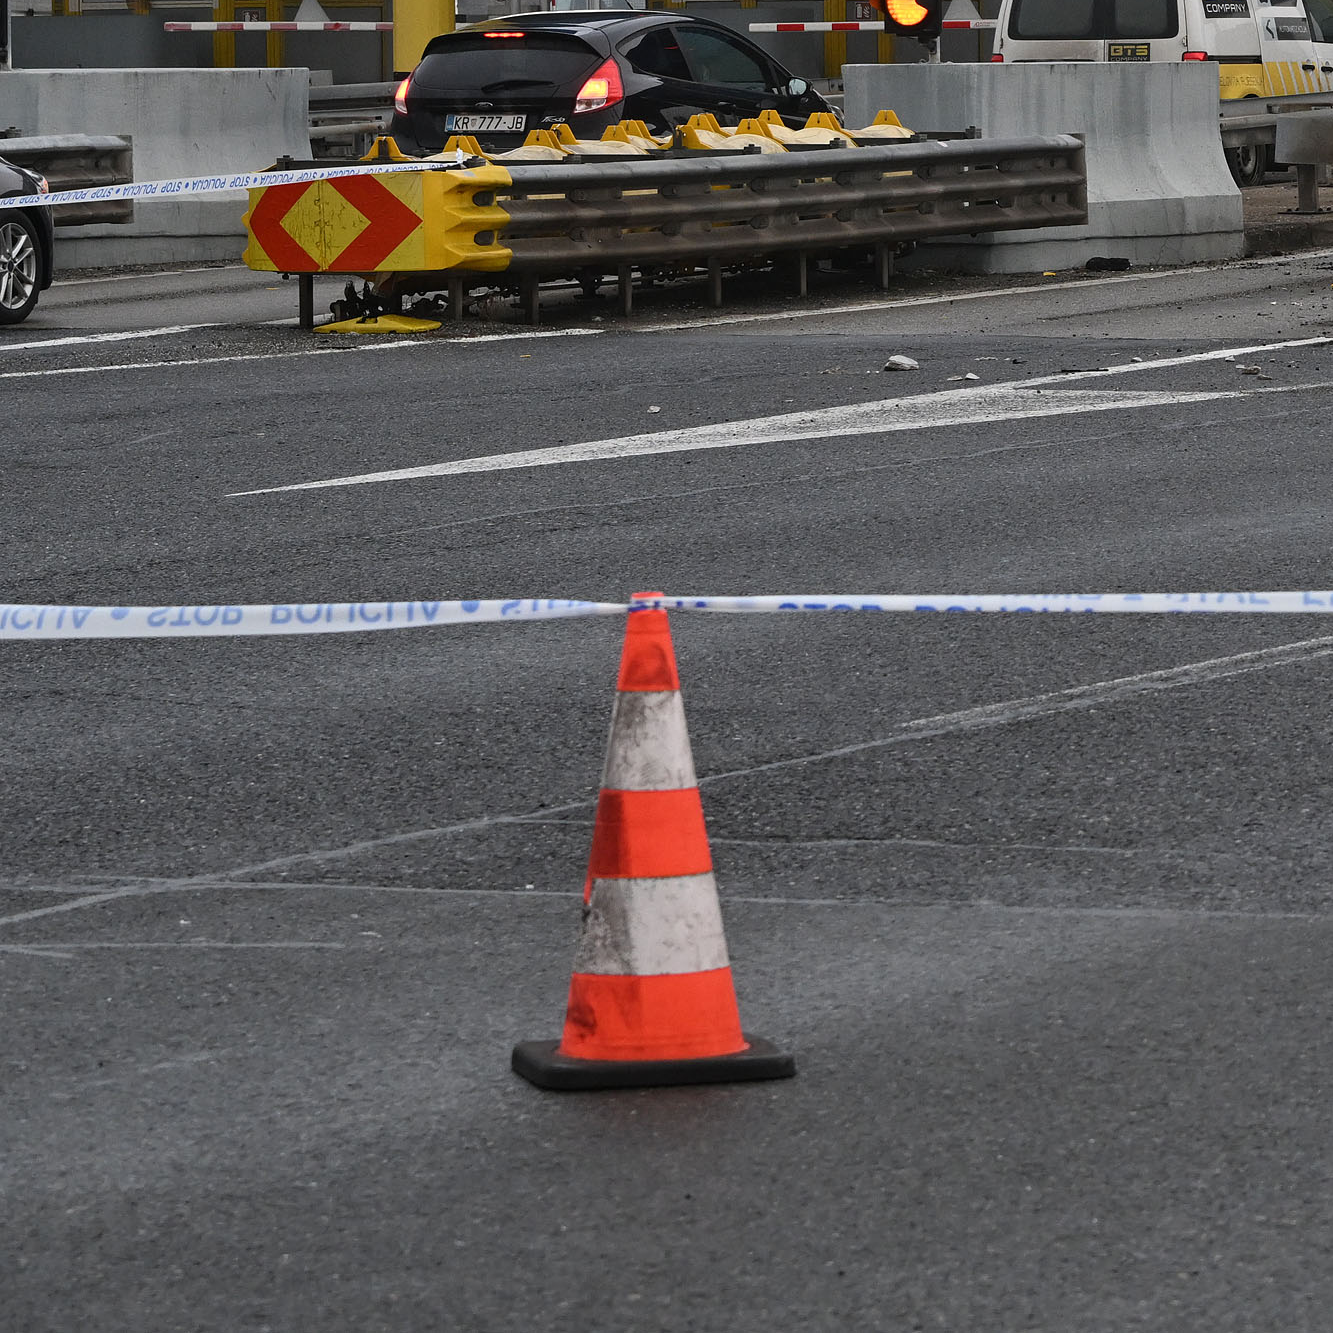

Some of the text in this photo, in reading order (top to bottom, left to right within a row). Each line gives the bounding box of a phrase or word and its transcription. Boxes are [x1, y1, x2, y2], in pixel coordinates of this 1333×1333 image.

[1205, 3, 1247, 13] COMPANY
[1110, 45, 1149, 56] BTS
[454, 117, 470, 130] KR
[160, 181, 183, 193] STOP
[192, 177, 227, 191] POLICIJA
[230, 176, 251, 188] STOP
[91, 189, 112, 199] STOP
[122, 184, 157, 196] POLICIJA
